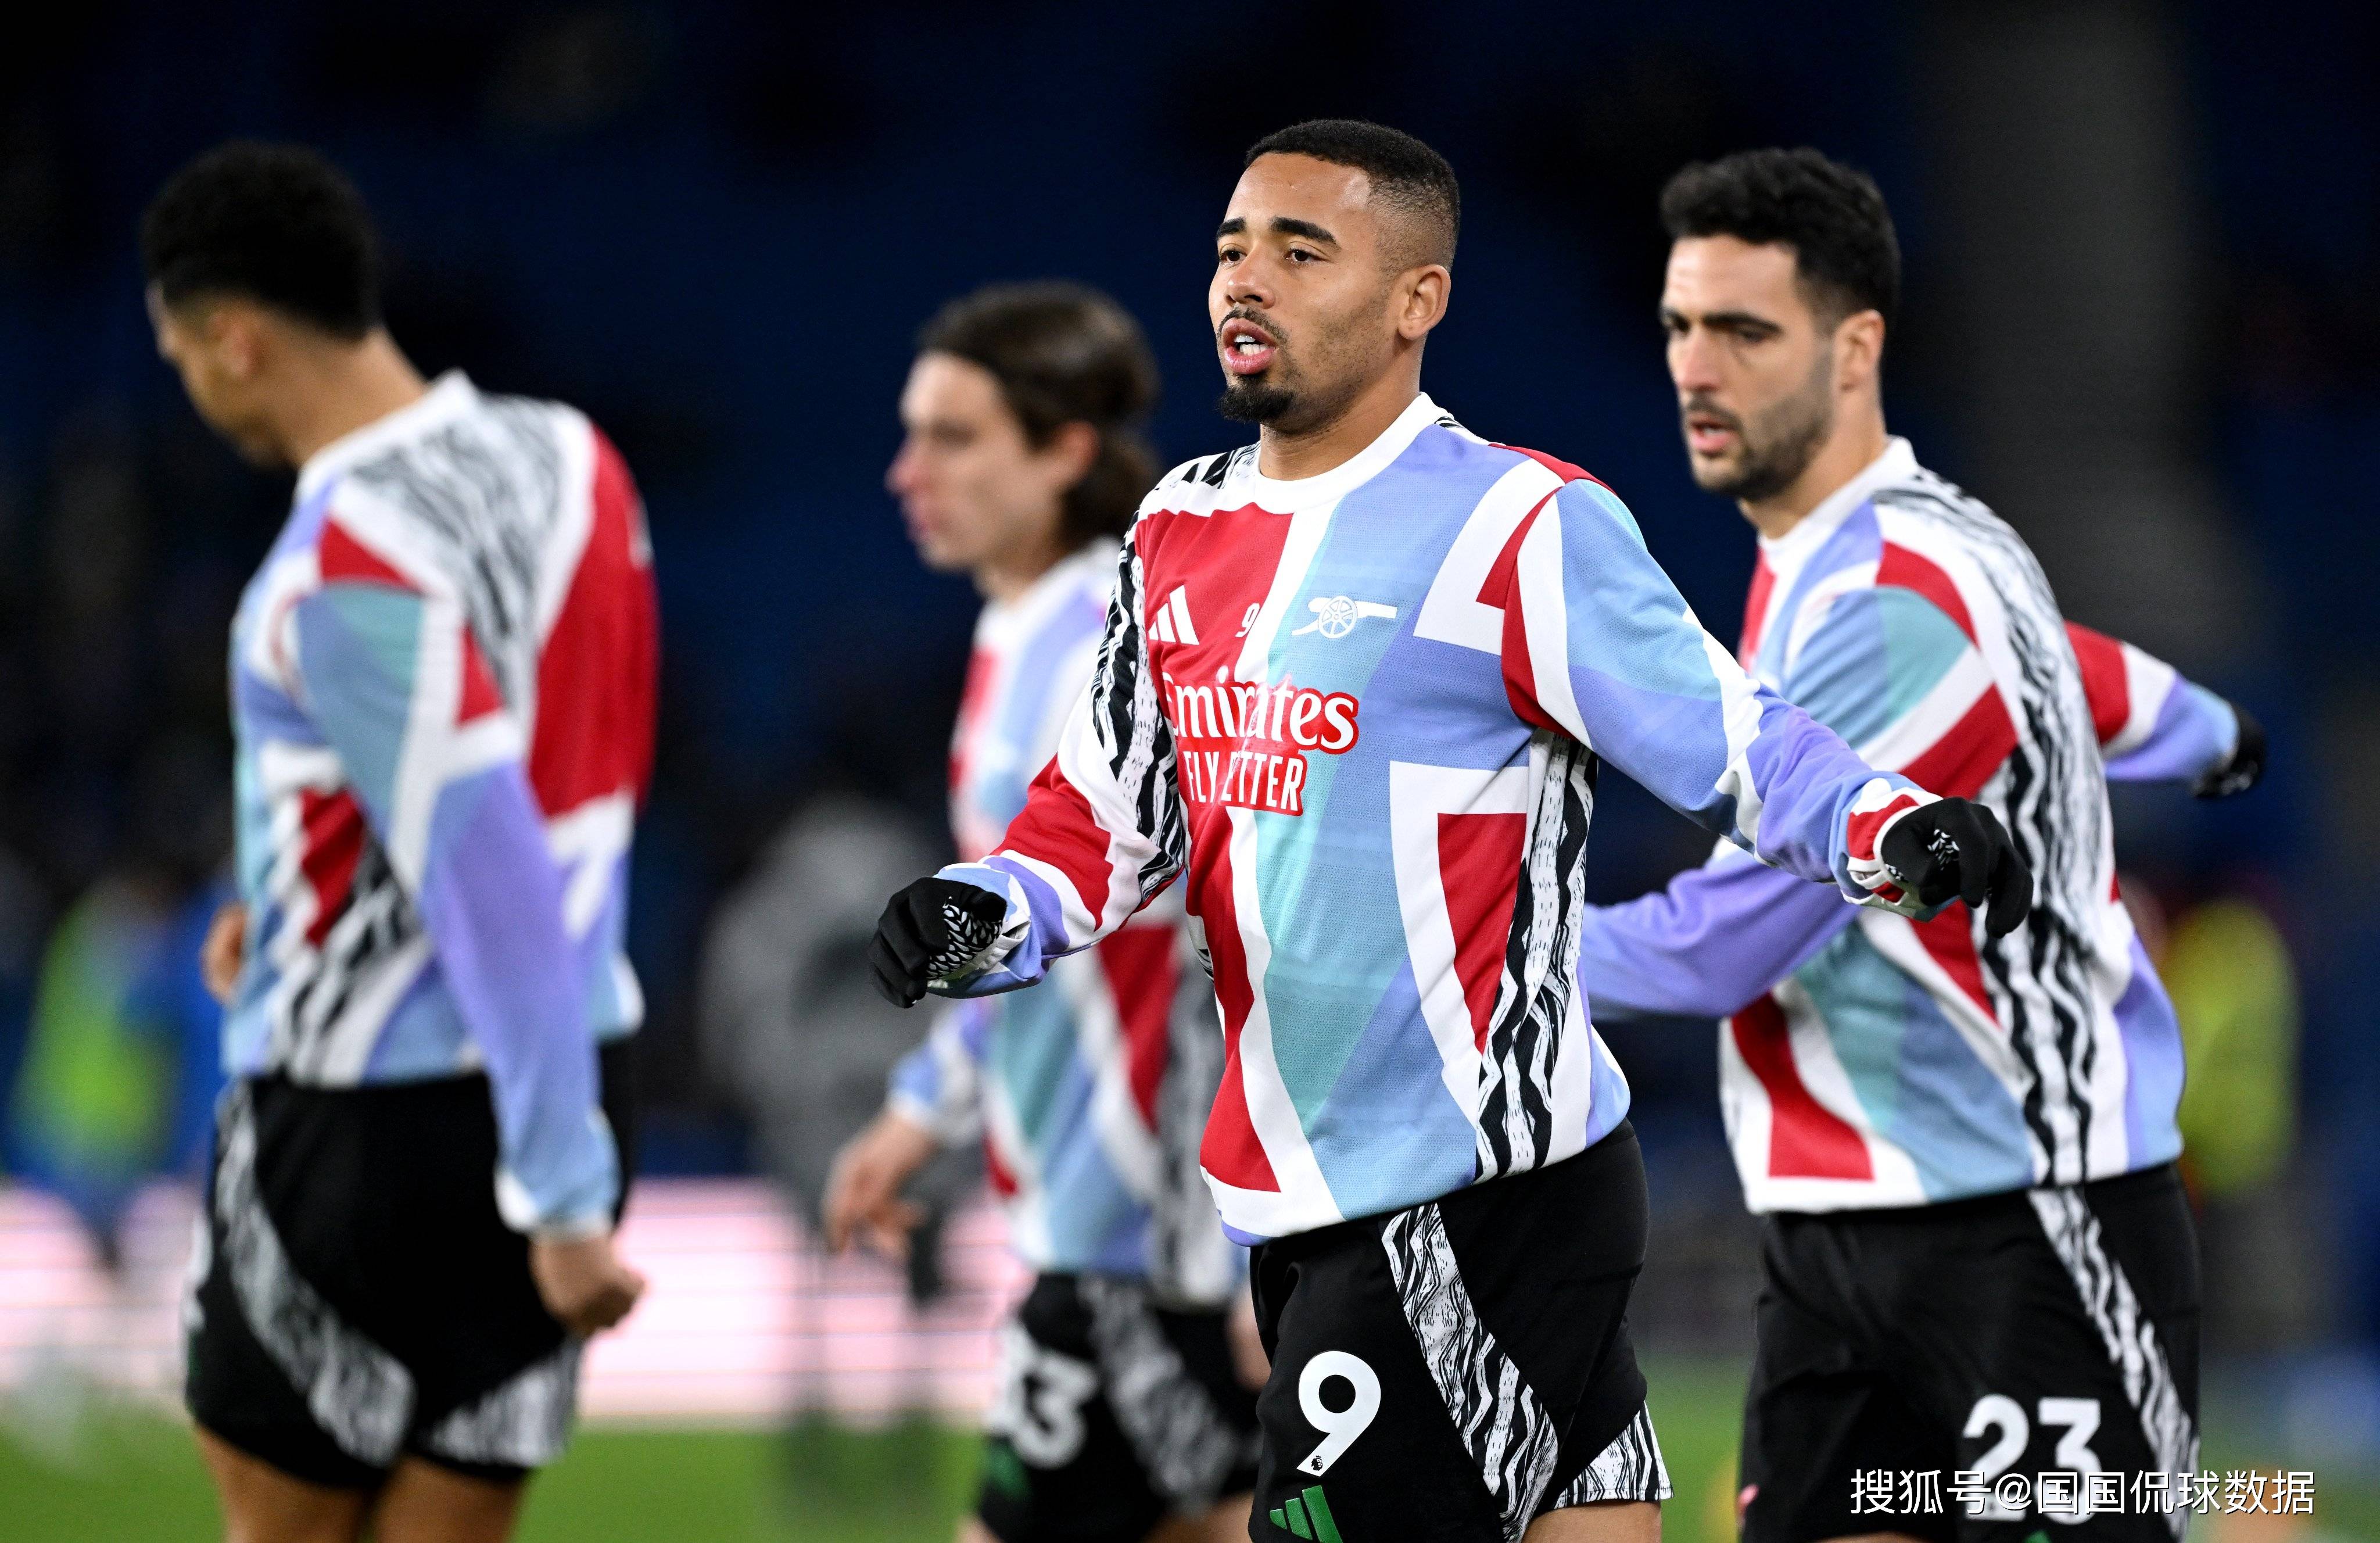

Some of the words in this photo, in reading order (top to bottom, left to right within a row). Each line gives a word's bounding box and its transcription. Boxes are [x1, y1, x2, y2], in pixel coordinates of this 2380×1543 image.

[1235, 603, 1260, 638] 9
[1182, 751, 1220, 804] FLY
[1296, 1351, 1381, 1477] 9
[1963, 1394, 2105, 1524] 23
